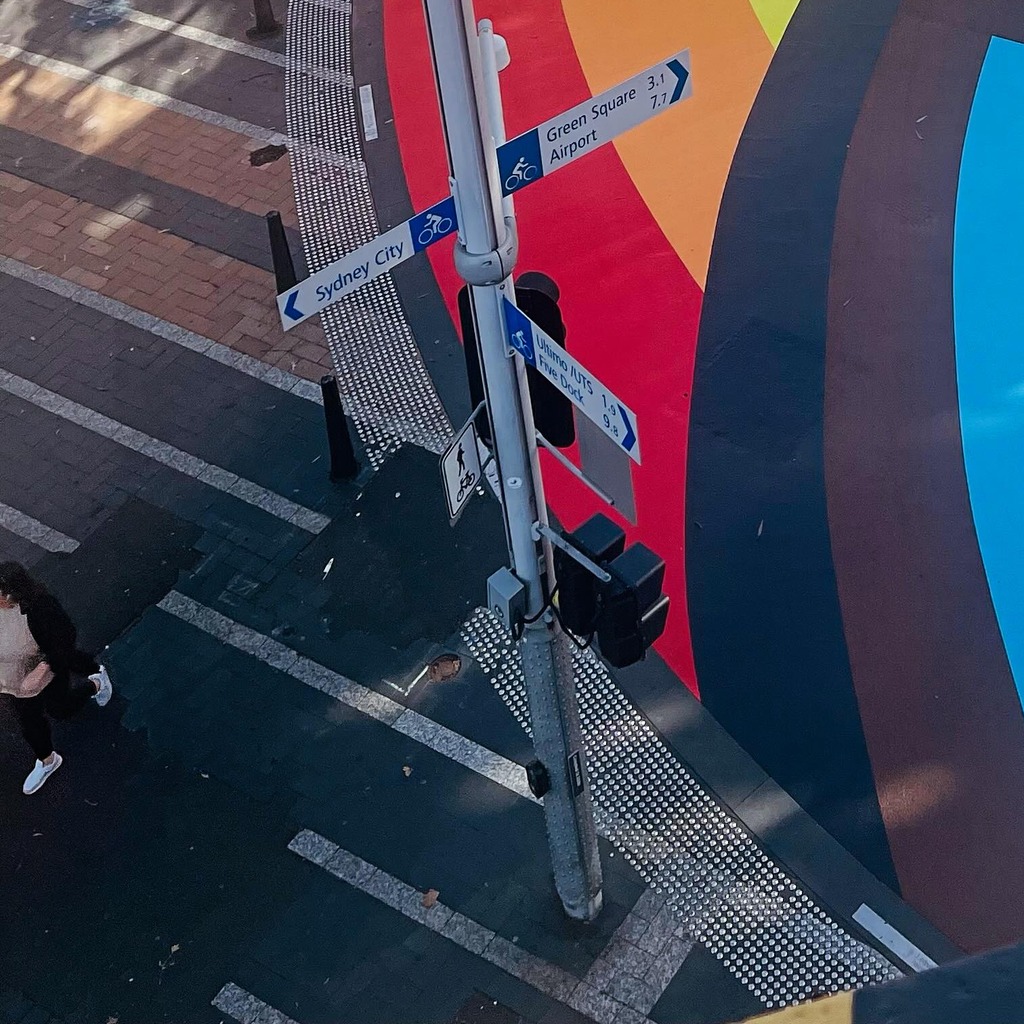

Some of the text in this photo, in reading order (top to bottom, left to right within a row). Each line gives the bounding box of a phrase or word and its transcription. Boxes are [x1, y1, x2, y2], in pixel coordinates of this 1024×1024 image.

[546, 73, 666, 143] Green Square 3.1
[549, 92, 668, 165] Airport 7.7
[315, 241, 404, 302] Sydney City
[536, 334, 617, 416] Ultimo /UTS 1.9
[538, 355, 619, 438] Five Dock 9.8
